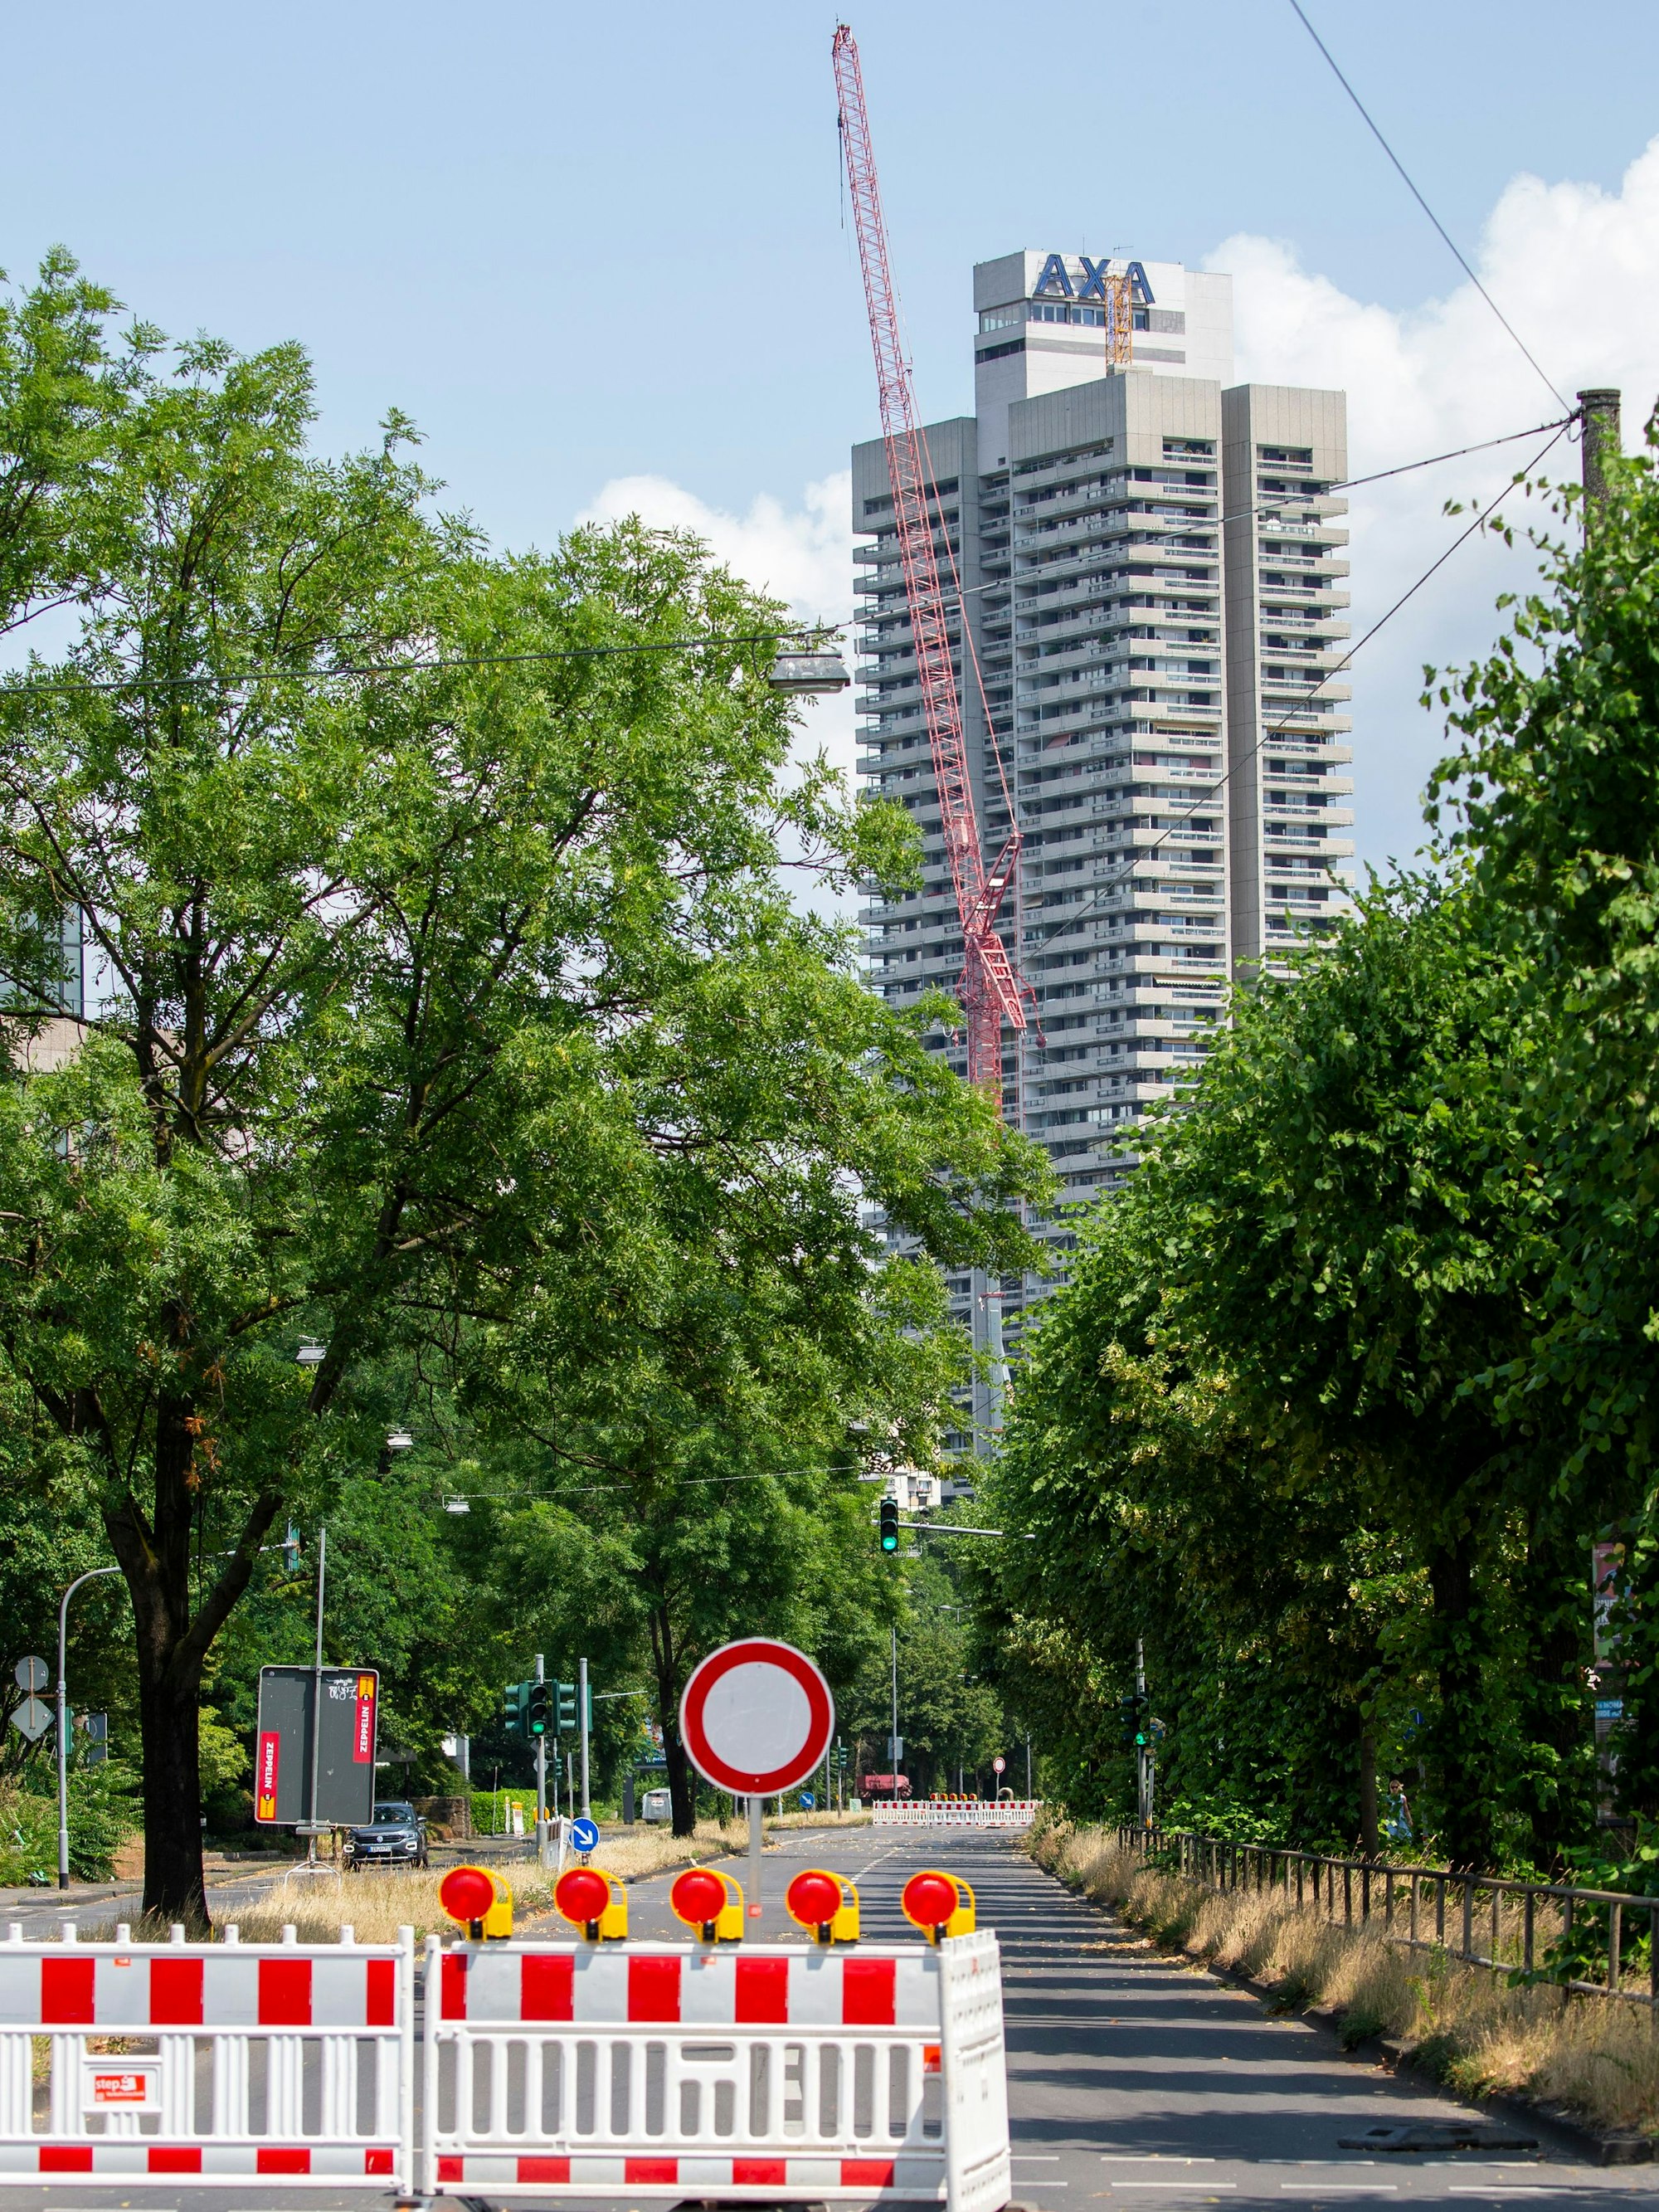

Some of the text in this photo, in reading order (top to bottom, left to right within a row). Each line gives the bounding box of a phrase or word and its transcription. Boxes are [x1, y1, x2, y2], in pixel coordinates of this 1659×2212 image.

[1036, 254, 1155, 304] AXA
[360, 1706, 370, 1752] ZEPPELIN
[265, 1742, 275, 1789] ZEPPELIN
